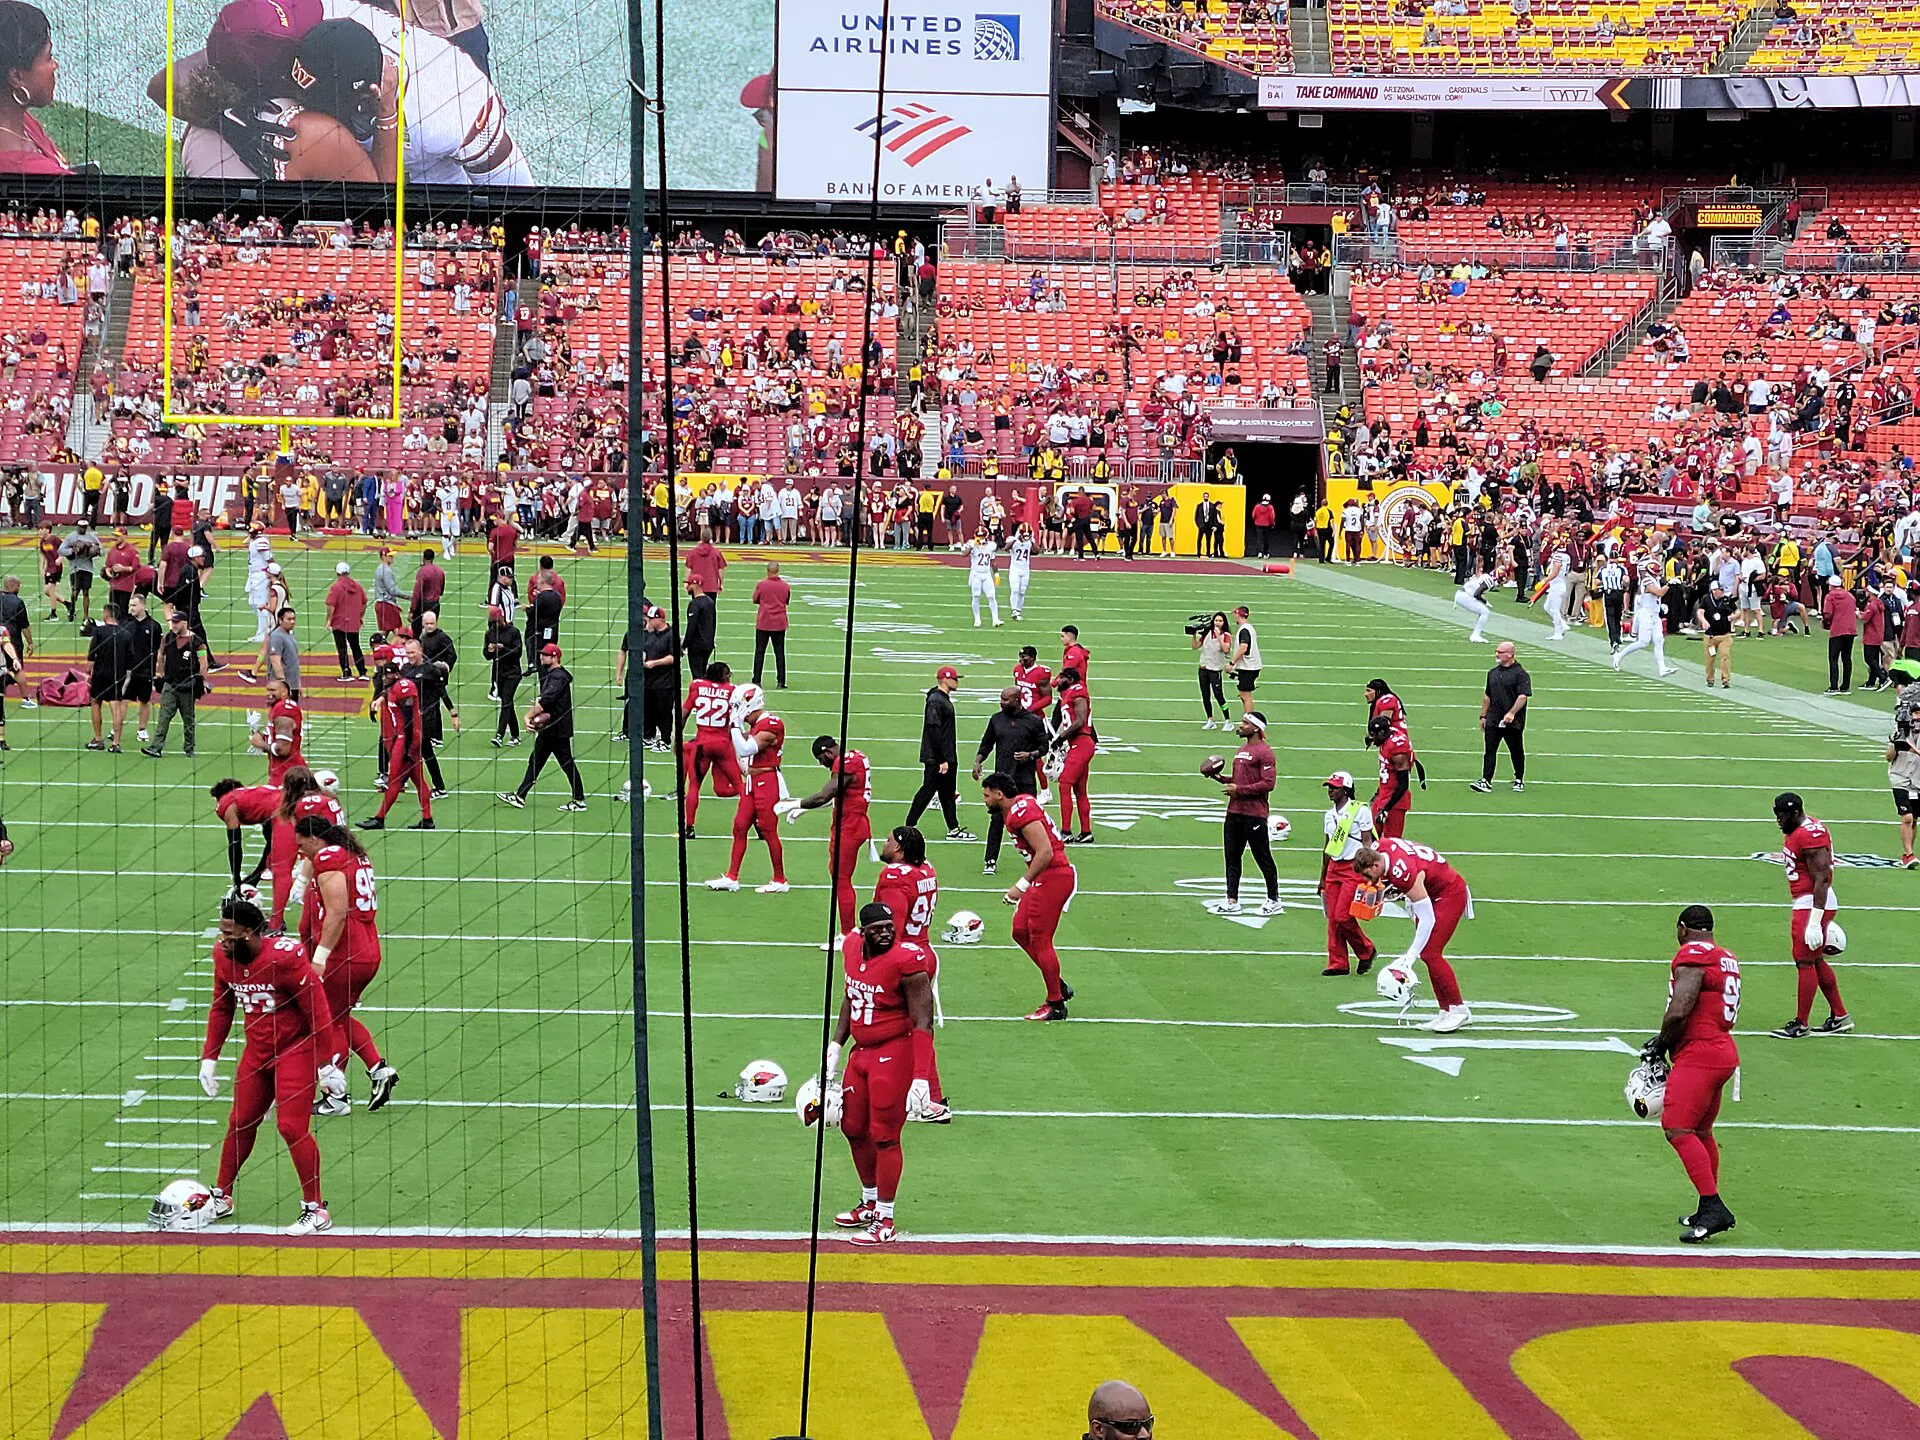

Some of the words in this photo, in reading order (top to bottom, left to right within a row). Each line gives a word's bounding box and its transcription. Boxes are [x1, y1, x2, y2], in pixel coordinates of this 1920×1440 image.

[841, 14, 962, 32] UNITED
[809, 37, 961, 55] AIRLINES
[1296, 85, 1322, 98] TAKE
[1322, 86, 1378, 99] COMMAND
[1448, 86, 1489, 94] CARDINALS
[883, 183, 906, 195] OF
[1697, 213, 1762, 223] COMMANDERS
[459, 487, 469, 498] 10
[786, 497, 795, 507] 21
[977, 553, 990, 567] 23
[1016, 549, 1029, 562] 24
[698, 686, 729, 699] WALLACE
[694, 697, 729, 727] 22
